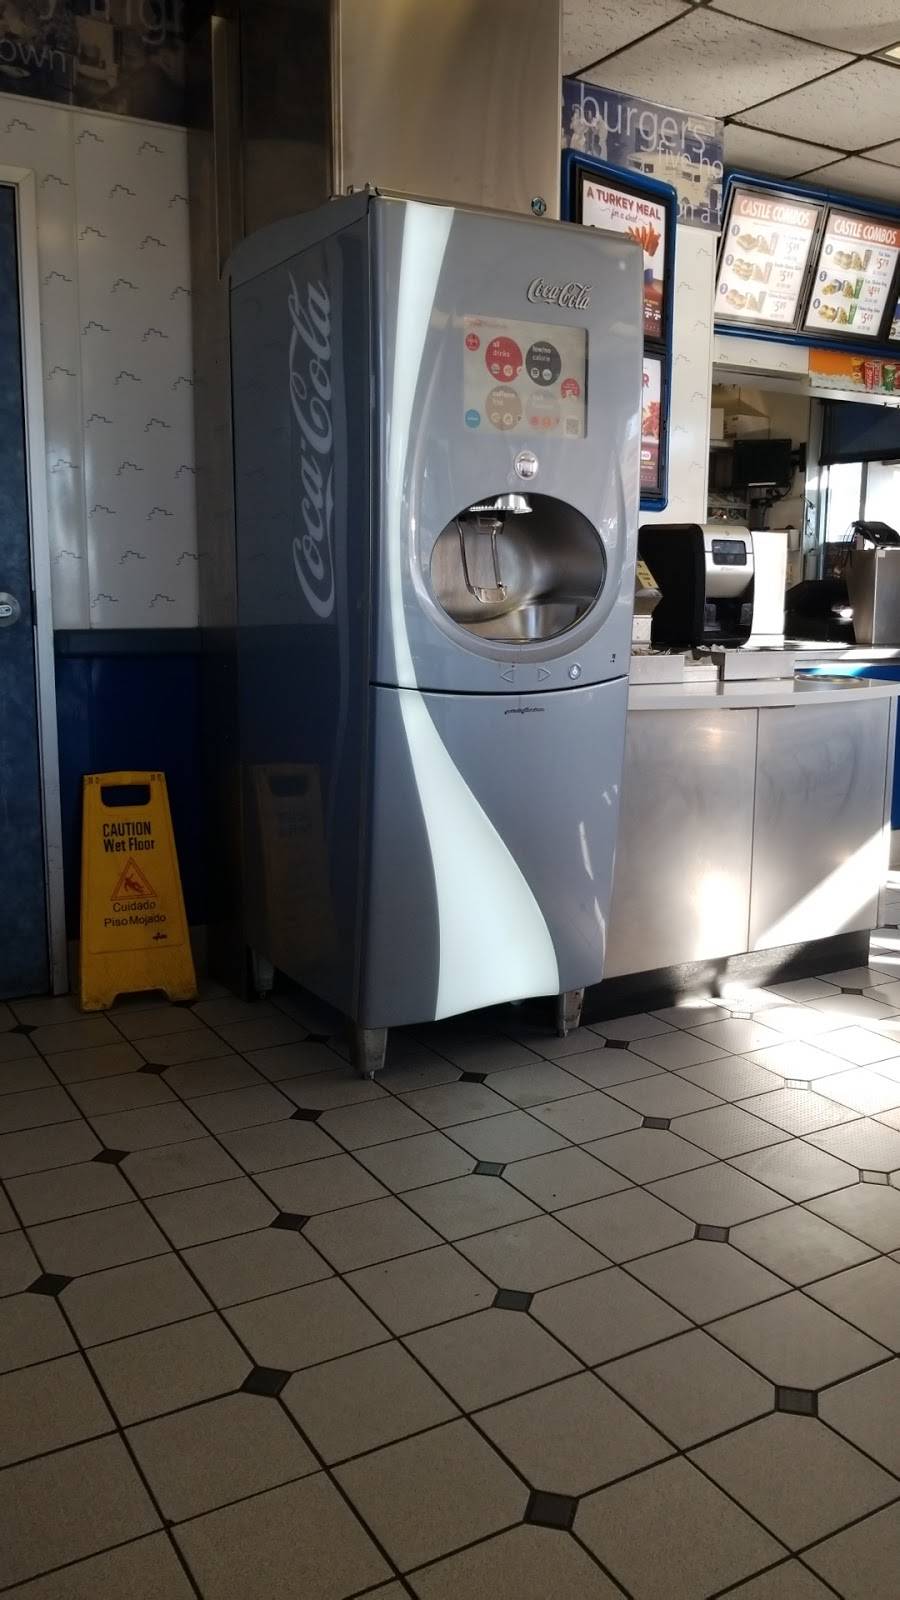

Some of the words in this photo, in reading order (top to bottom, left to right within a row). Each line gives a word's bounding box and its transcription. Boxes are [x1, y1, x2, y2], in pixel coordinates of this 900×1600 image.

[580, 82, 706, 153] burgers
[586, 186, 595, 199] A
[596, 189, 635, 211] TURKEY
[636, 203, 662, 220] MEAL
[740, 199, 770, 219] CASTLE
[771, 206, 810, 227] COMBOS
[833, 219, 861, 238] CASTLE
[862, 224, 897, 246] COMBOS
[527, 278, 591, 310] Coca-Cola
[288, 271, 335, 618] Coca-Cola
[102, 821, 152, 838] CAUTION
[103, 839, 126, 852] Wet
[129, 837, 155, 851] Floor
[112, 901, 156, 912] Cuidado
[104, 918, 128, 927] Piso
[129, 914, 167, 926] Mojado
